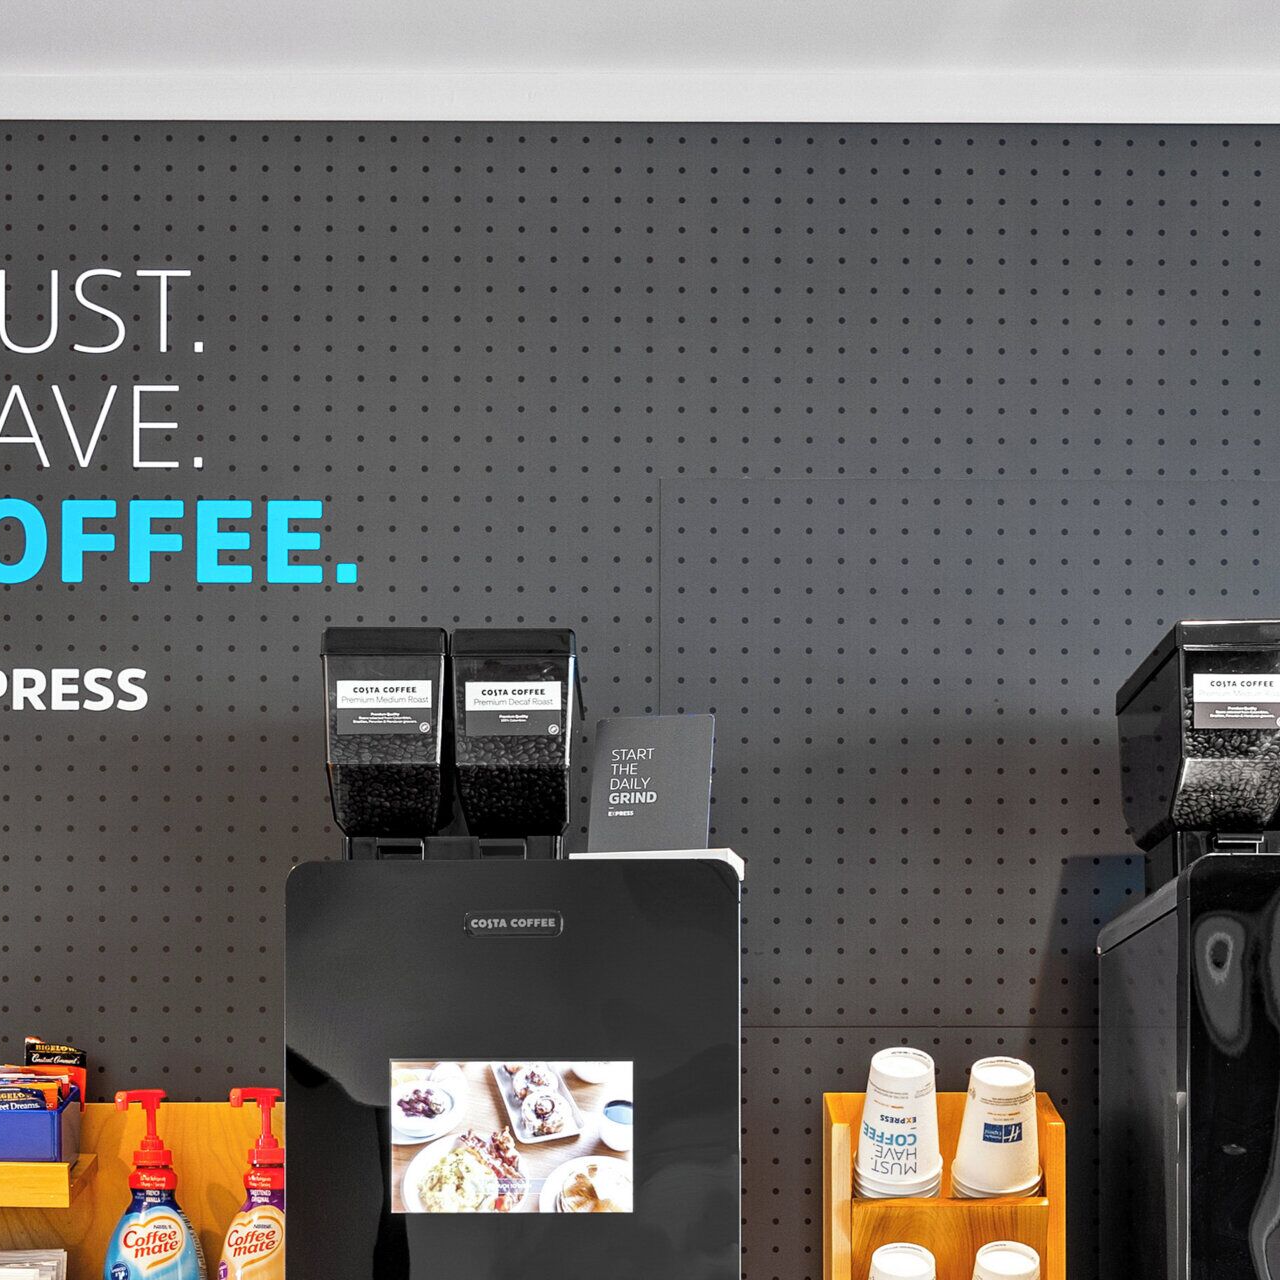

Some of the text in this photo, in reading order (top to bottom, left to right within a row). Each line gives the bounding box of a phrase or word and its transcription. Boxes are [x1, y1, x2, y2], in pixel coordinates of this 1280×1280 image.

[353, 686, 417, 694] COSTA COFFEE
[1210, 680, 1274, 688] COSTA COFFEE
[481, 688, 545, 696] COSTA COFFEE
[341, 695, 429, 704] Premium Medium Roast
[474, 697, 553, 706] Premium Decaf Roast
[611, 748, 655, 761] START
[611, 763, 638, 775] THE
[610, 777, 651, 790] DAILY
[608, 791, 658, 805] GRIND
[470, 918, 556, 928] COSTA COFFEE
[880, 1114, 917, 1125] EXPRESS
[123, 1230, 177, 1248] Coffee
[227, 1229, 276, 1248] Coffee
[134, 1240, 179, 1258] mate
[233, 1240, 276, 1257] mate
